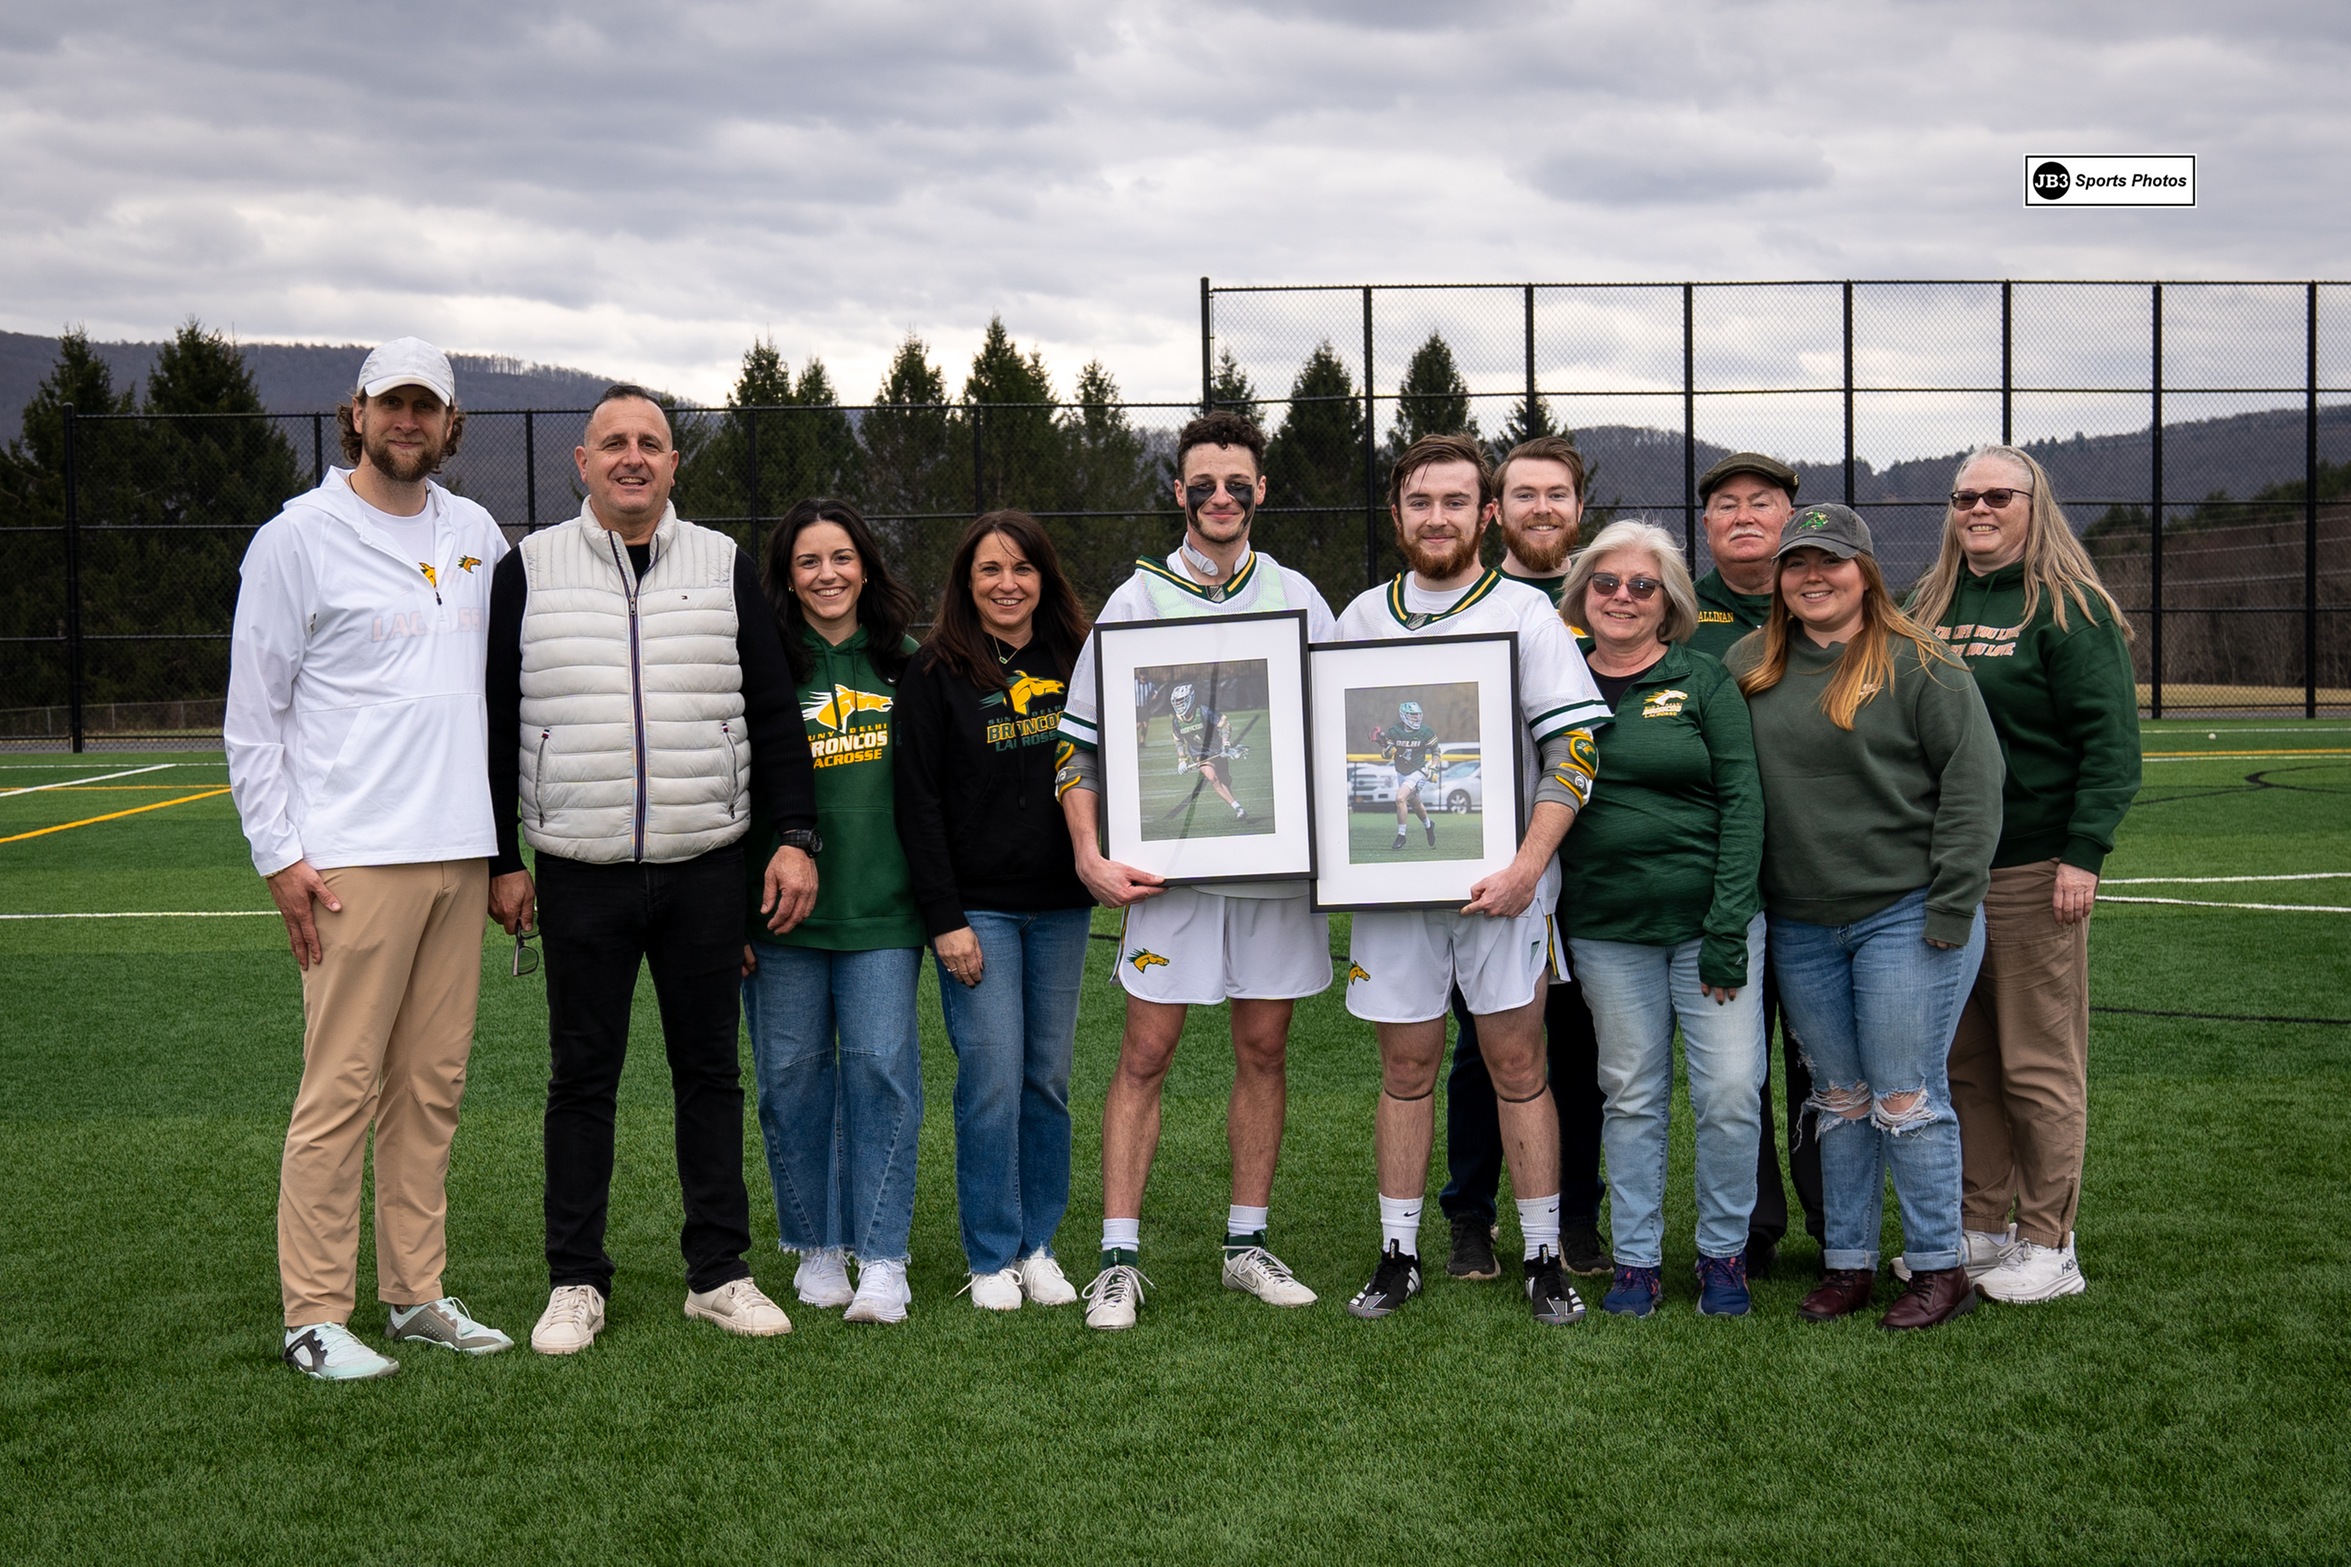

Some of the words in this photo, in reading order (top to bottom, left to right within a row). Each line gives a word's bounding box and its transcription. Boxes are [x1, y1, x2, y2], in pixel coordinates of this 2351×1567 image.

[1697, 611, 1734, 623] ALLINAN
[808, 731, 835, 742] UNY
[849, 723, 887, 734] DELHI
[995, 730, 1059, 752] LAROSS
[809, 730, 888, 758] RONCOS
[813, 748, 883, 769] ACROSSE
